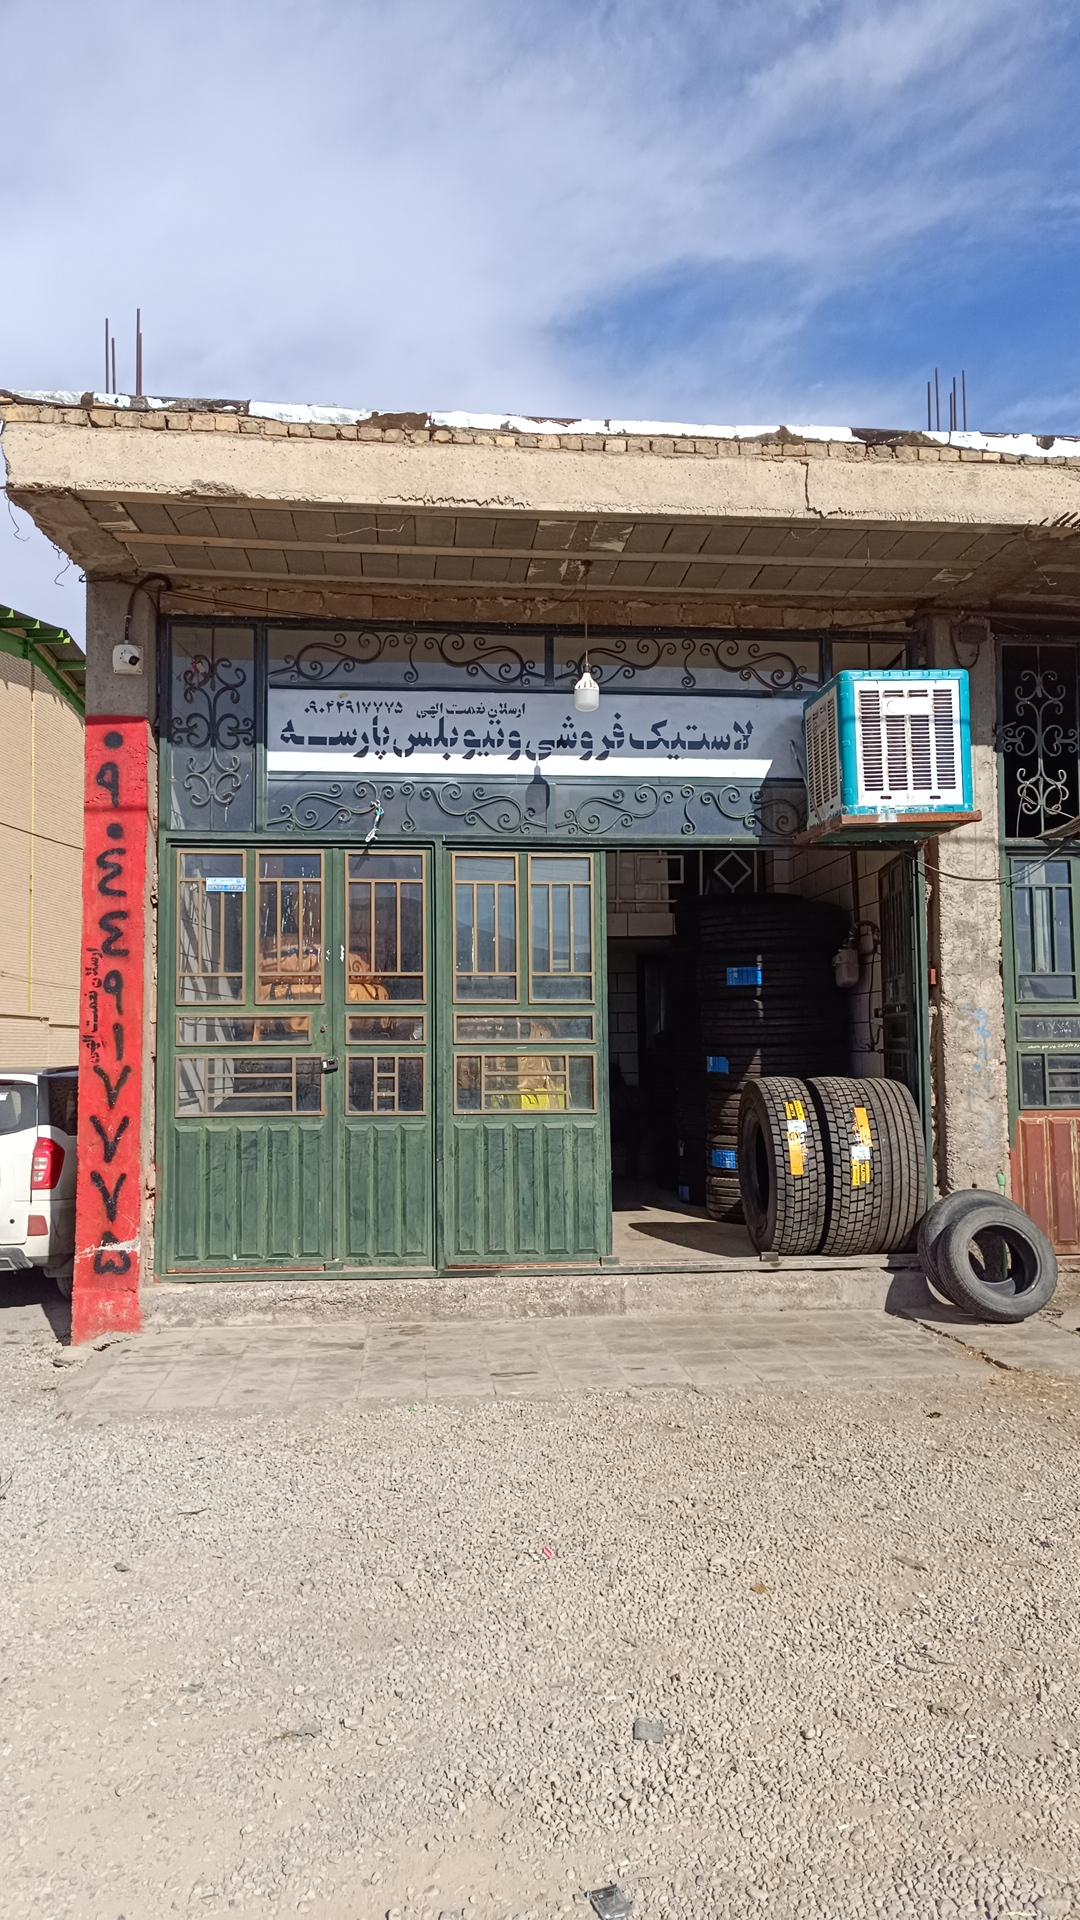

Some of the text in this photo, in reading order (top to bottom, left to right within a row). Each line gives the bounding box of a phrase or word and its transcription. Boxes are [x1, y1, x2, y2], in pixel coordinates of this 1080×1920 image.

[304, 700, 404, 714] ۰۹۰۴۴۹۱۷۷۷۵
[416, 702, 526, 718] ارسلان نعمت الهی
[280, 714, 390, 760] پارسه
[525, 712, 625, 761] فروشی
[629, 720, 754, 760] لاستیک
